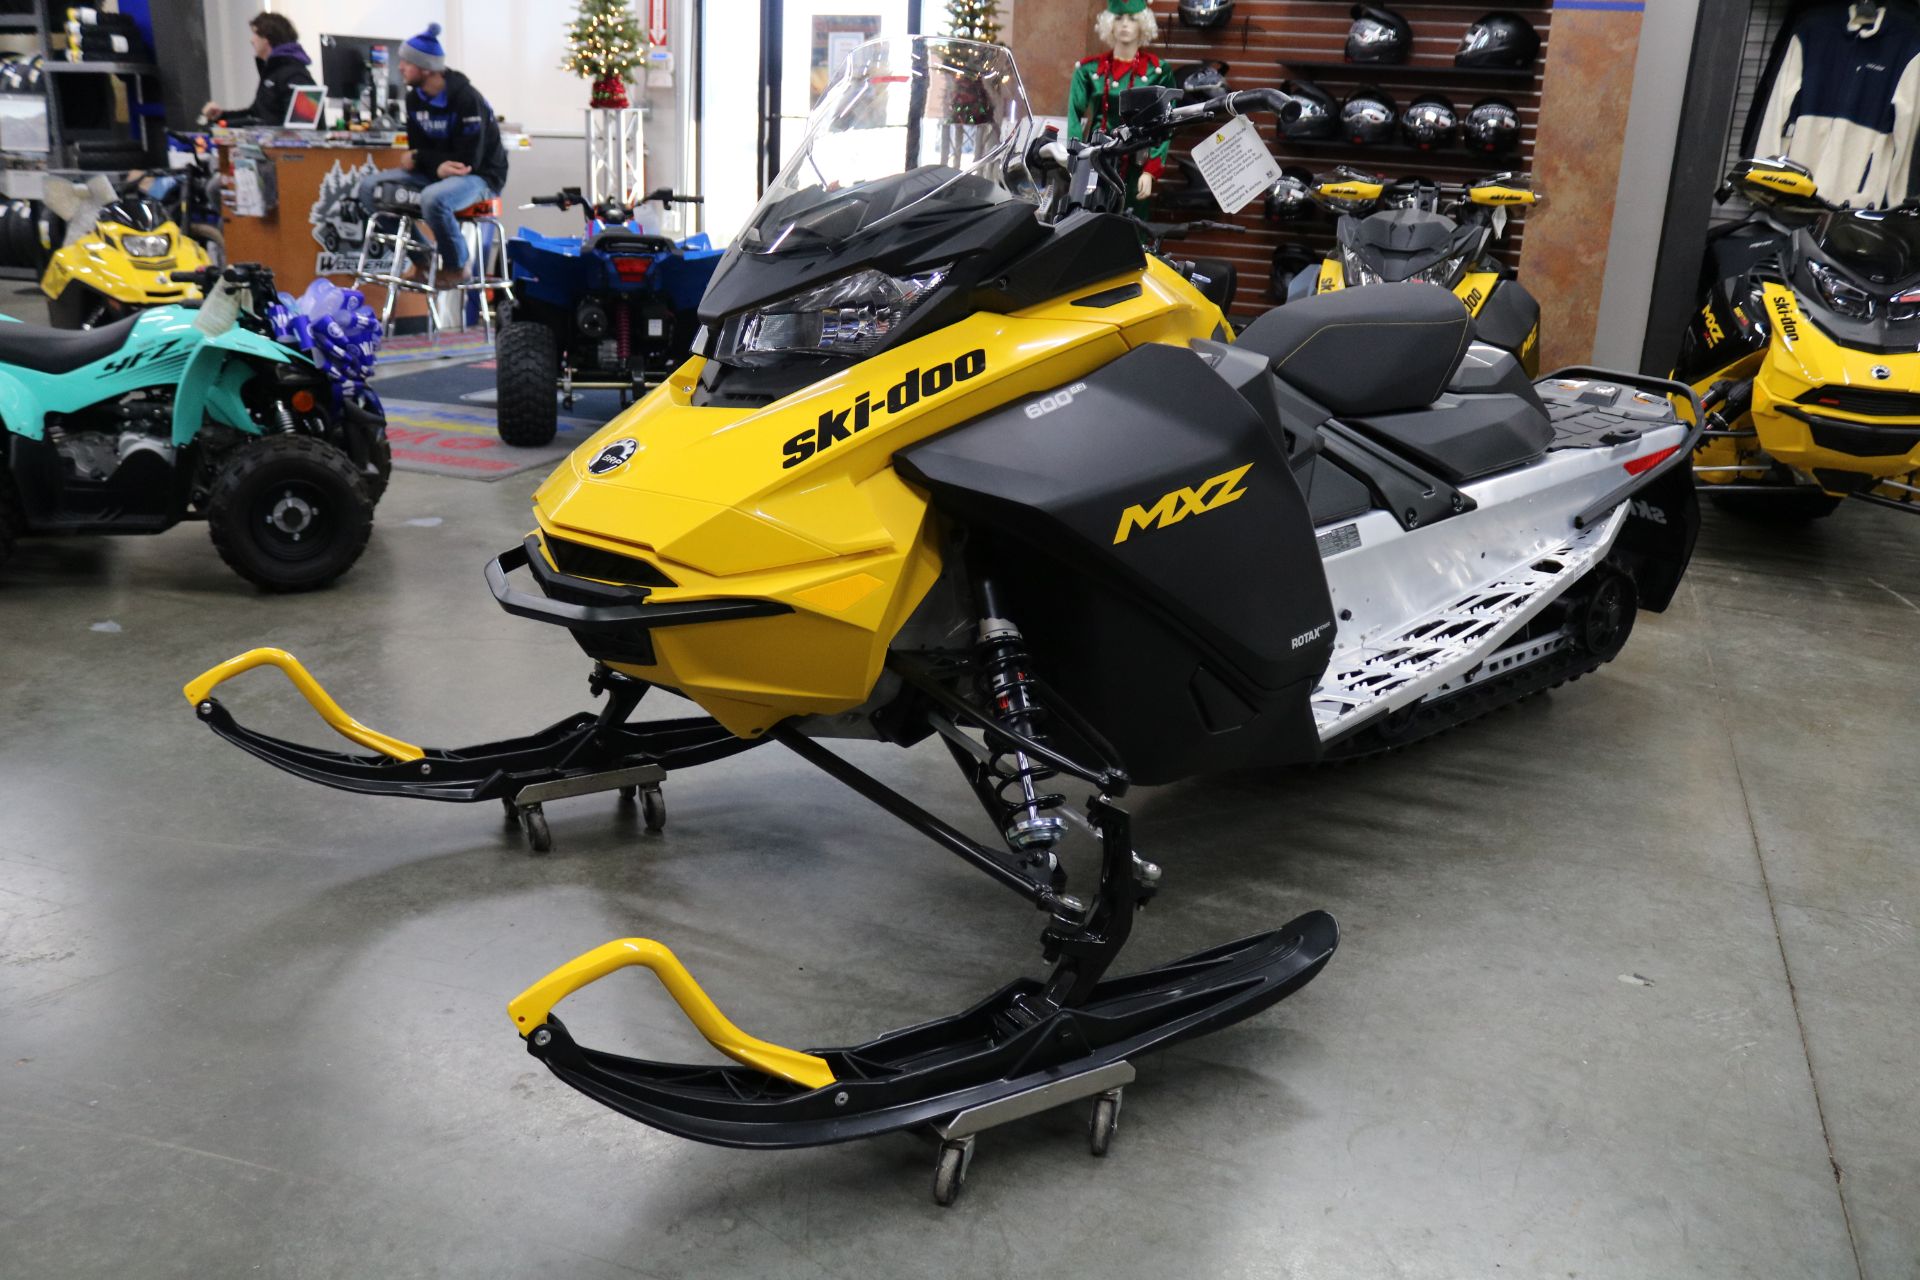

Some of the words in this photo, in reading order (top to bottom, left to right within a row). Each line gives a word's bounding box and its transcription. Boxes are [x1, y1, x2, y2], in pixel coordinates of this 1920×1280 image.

[1773, 297, 1799, 342] ski-doo
[782, 348, 986, 469] ski-doo
[1025, 391, 1073, 419] 600
[601, 454, 623, 465] BRP
[1113, 462, 1255, 545] MXZ
[1291, 626, 1321, 650] ROTAX
